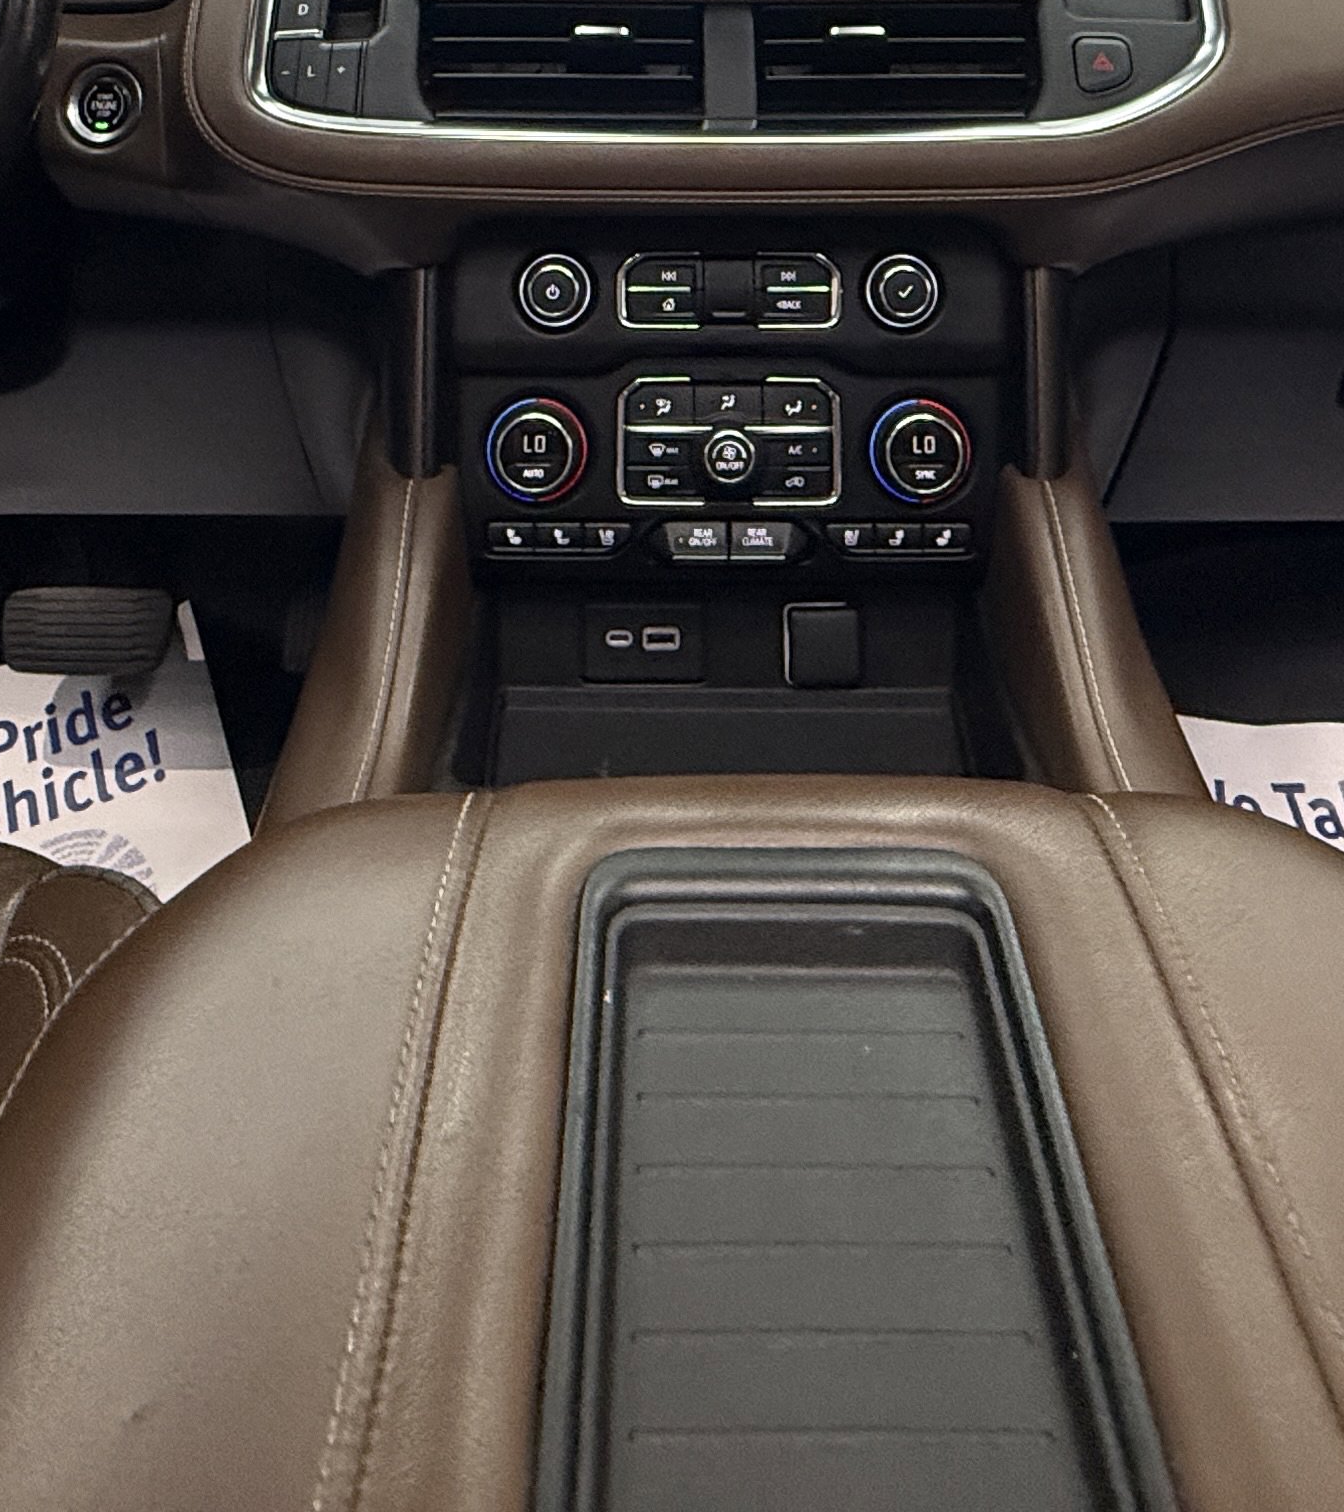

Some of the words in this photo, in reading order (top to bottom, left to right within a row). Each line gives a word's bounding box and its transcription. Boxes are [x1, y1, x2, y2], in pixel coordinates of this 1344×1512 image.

[298, 4, 308, 16] D
[307, 66, 315, 77] L
[788, 445, 803, 456] A/C
[716, 462, 744, 471] ON/OFF
[693, 528, 713, 538] REAR
[747, 528, 767, 537] REAR
[688, 538, 717, 546] ON/OFF
